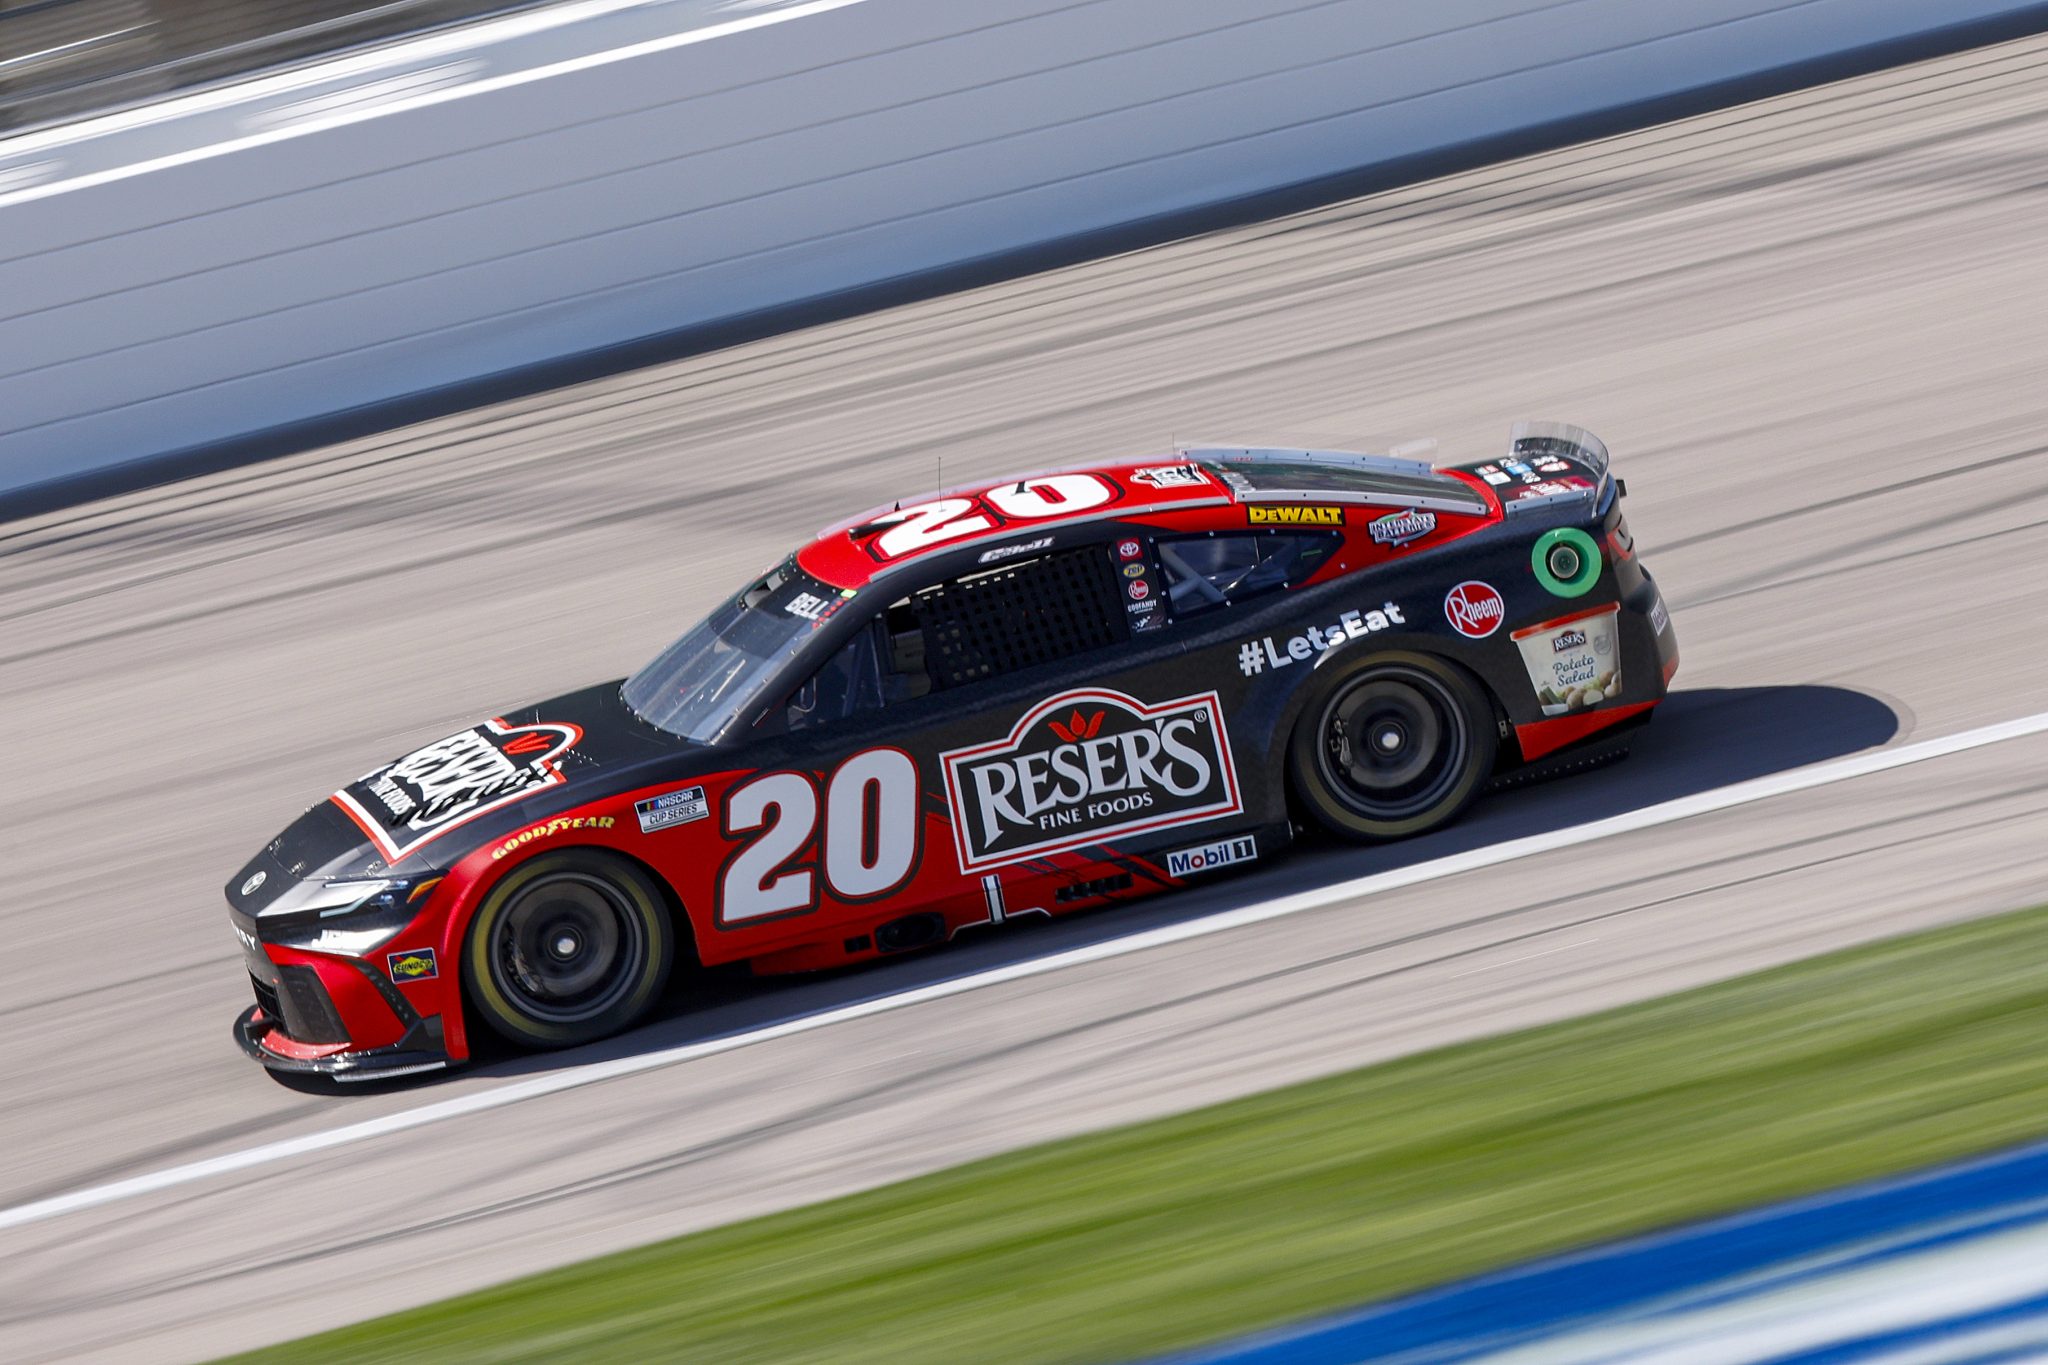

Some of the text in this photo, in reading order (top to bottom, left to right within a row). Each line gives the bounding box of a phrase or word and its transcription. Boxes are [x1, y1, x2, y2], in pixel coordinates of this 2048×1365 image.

[870, 474, 1112, 557] 20
[784, 592, 829, 620] BELL
[1449, 585, 1502, 630] Rheem
[1238, 601, 1405, 677] #LetsEat
[1553, 655, 1595, 675] Potato
[1557, 666, 1596, 687] Salad
[657, 790, 694, 809] NASCAR
[970, 718, 1211, 849] RESER'S
[649, 804, 698, 825] CUP SERIES
[1039, 791, 1154, 831] FINE FOODS
[491, 816, 616, 861] GOODYEAR
[722, 748, 918, 924] 20
[1170, 841, 1248, 874] Mobil 1
